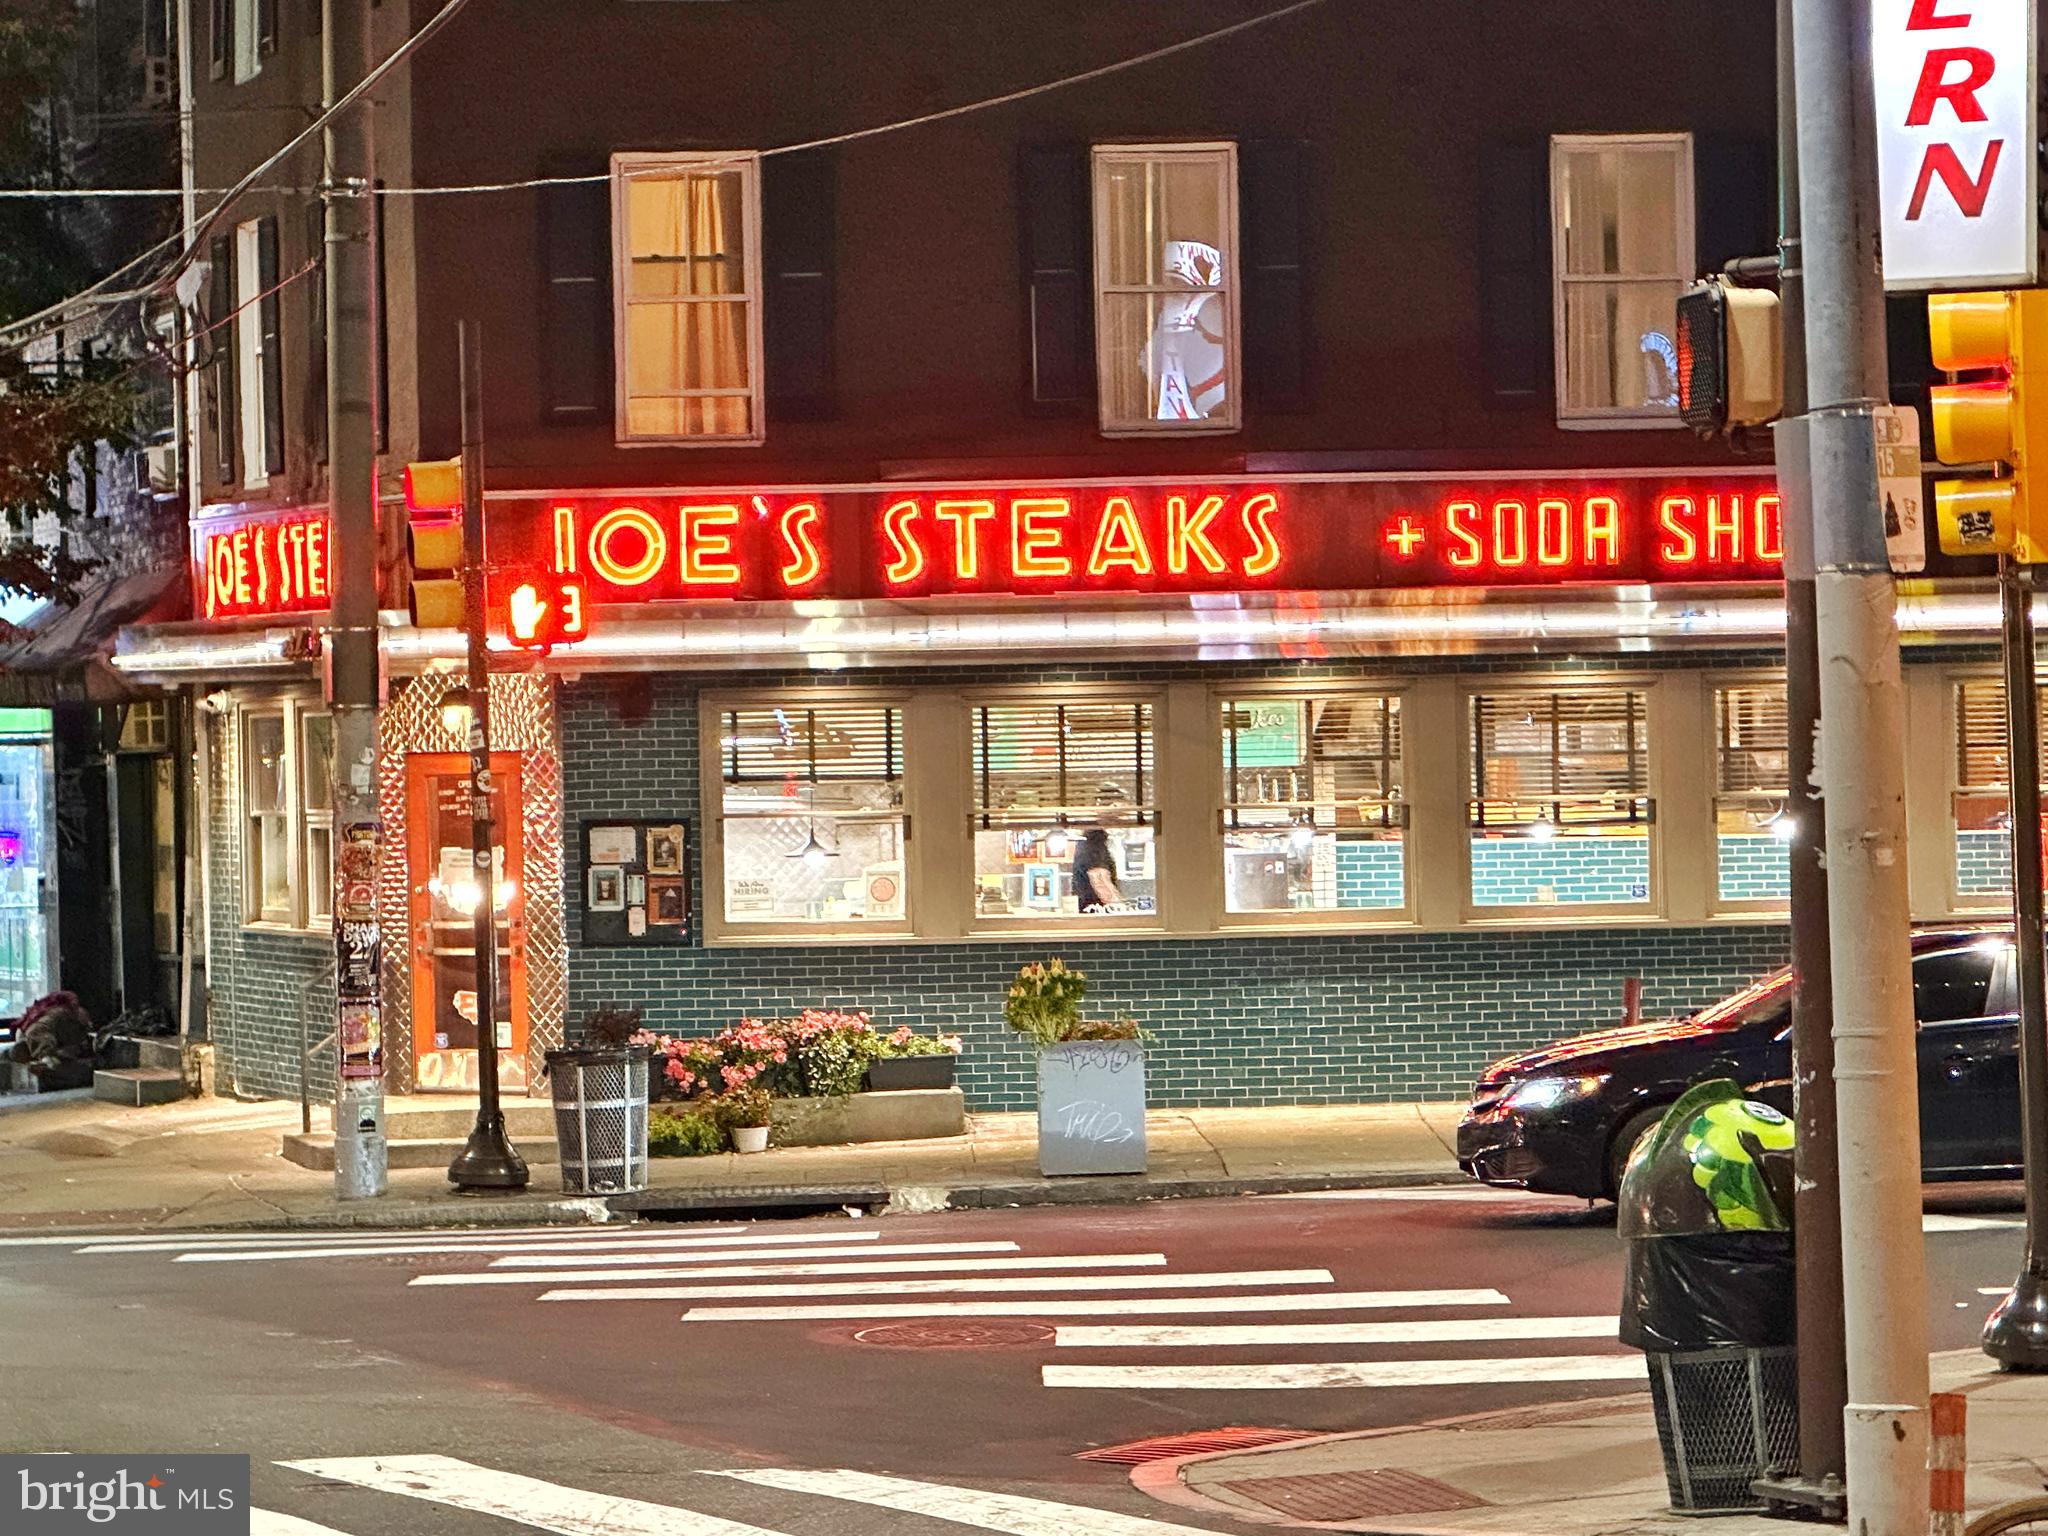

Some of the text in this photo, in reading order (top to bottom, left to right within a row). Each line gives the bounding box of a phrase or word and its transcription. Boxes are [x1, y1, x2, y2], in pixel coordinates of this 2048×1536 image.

[206, 519, 332, 619] JOE'S STE
[883, 494, 1282, 583] STEAKS
[1446, 497, 1619, 567] SODA
[561, 585, 581, 633] 3
[733, 887, 769, 896] HIRING
